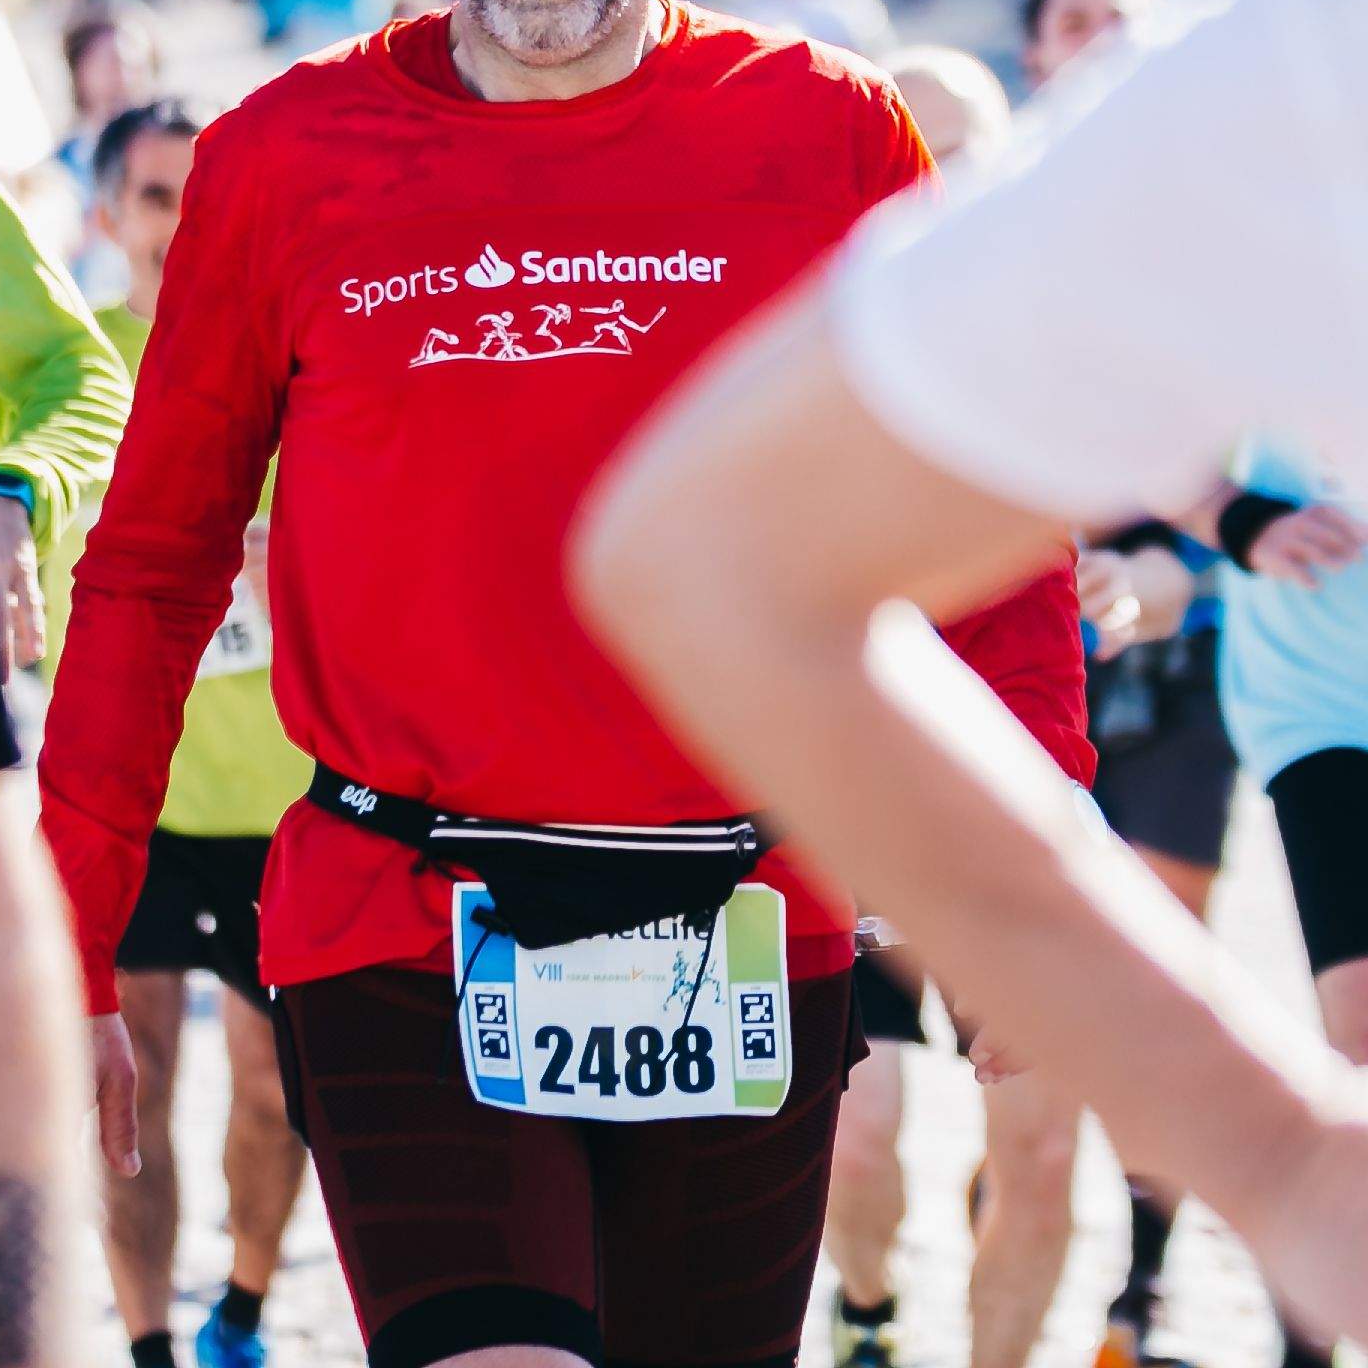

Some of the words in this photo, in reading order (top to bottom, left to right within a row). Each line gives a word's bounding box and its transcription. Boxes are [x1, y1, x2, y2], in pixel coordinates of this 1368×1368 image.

[340, 265, 459, 316] Sports
[520, 249, 727, 284] Santander
[340, 785, 378, 815] edp
[534, 962, 563, 981] VIII
[534, 1025, 715, 1097] 2488
